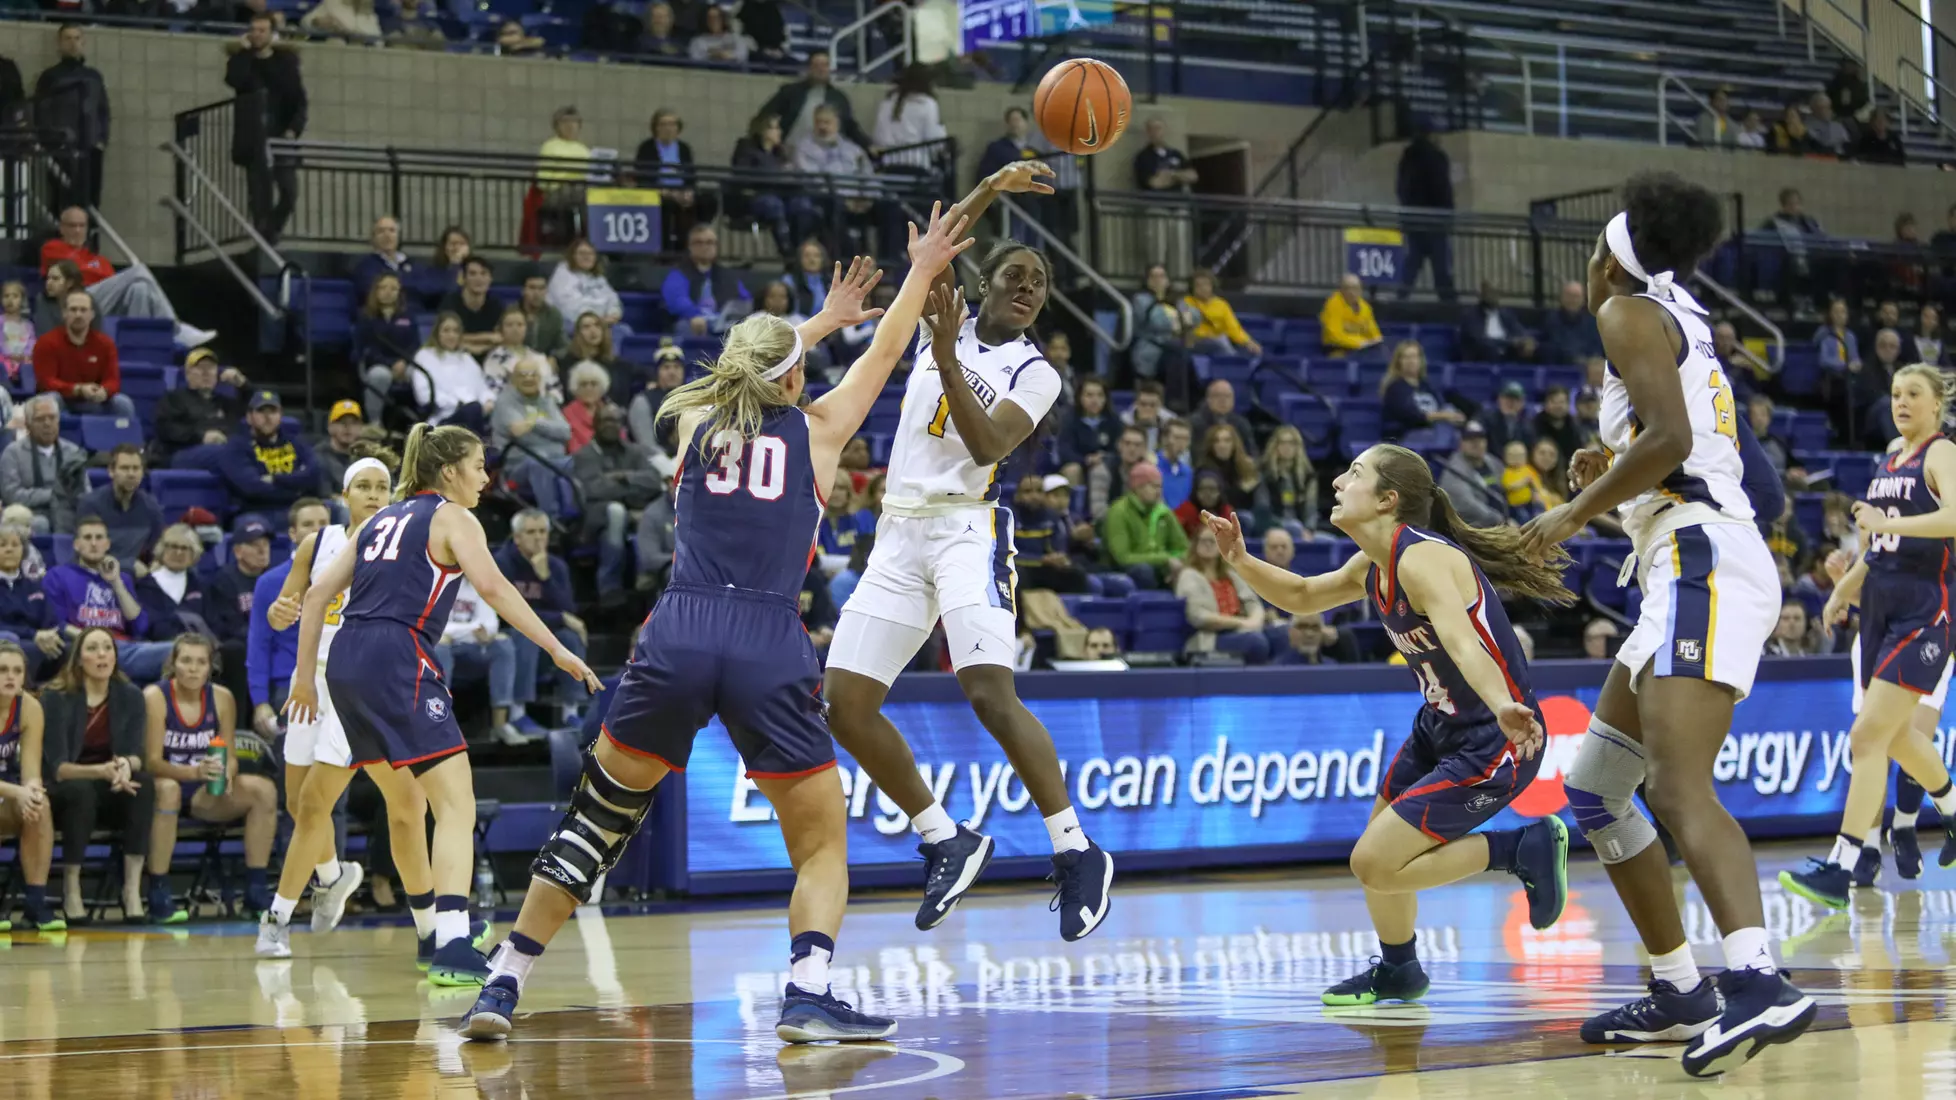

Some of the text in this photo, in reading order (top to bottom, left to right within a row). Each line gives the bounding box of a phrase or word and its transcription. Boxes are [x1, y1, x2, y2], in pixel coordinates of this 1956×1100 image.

[603, 212, 649, 243] 103
[1356, 248, 1395, 279] 104
[928, 392, 951, 439] 1
[704, 427, 788, 502] 30
[362, 512, 414, 562] 31
[1676, 638, 1703, 662] MU
[731, 729, 1384, 834] Eergy yo can depend
[1713, 730, 1812, 795] ergy
